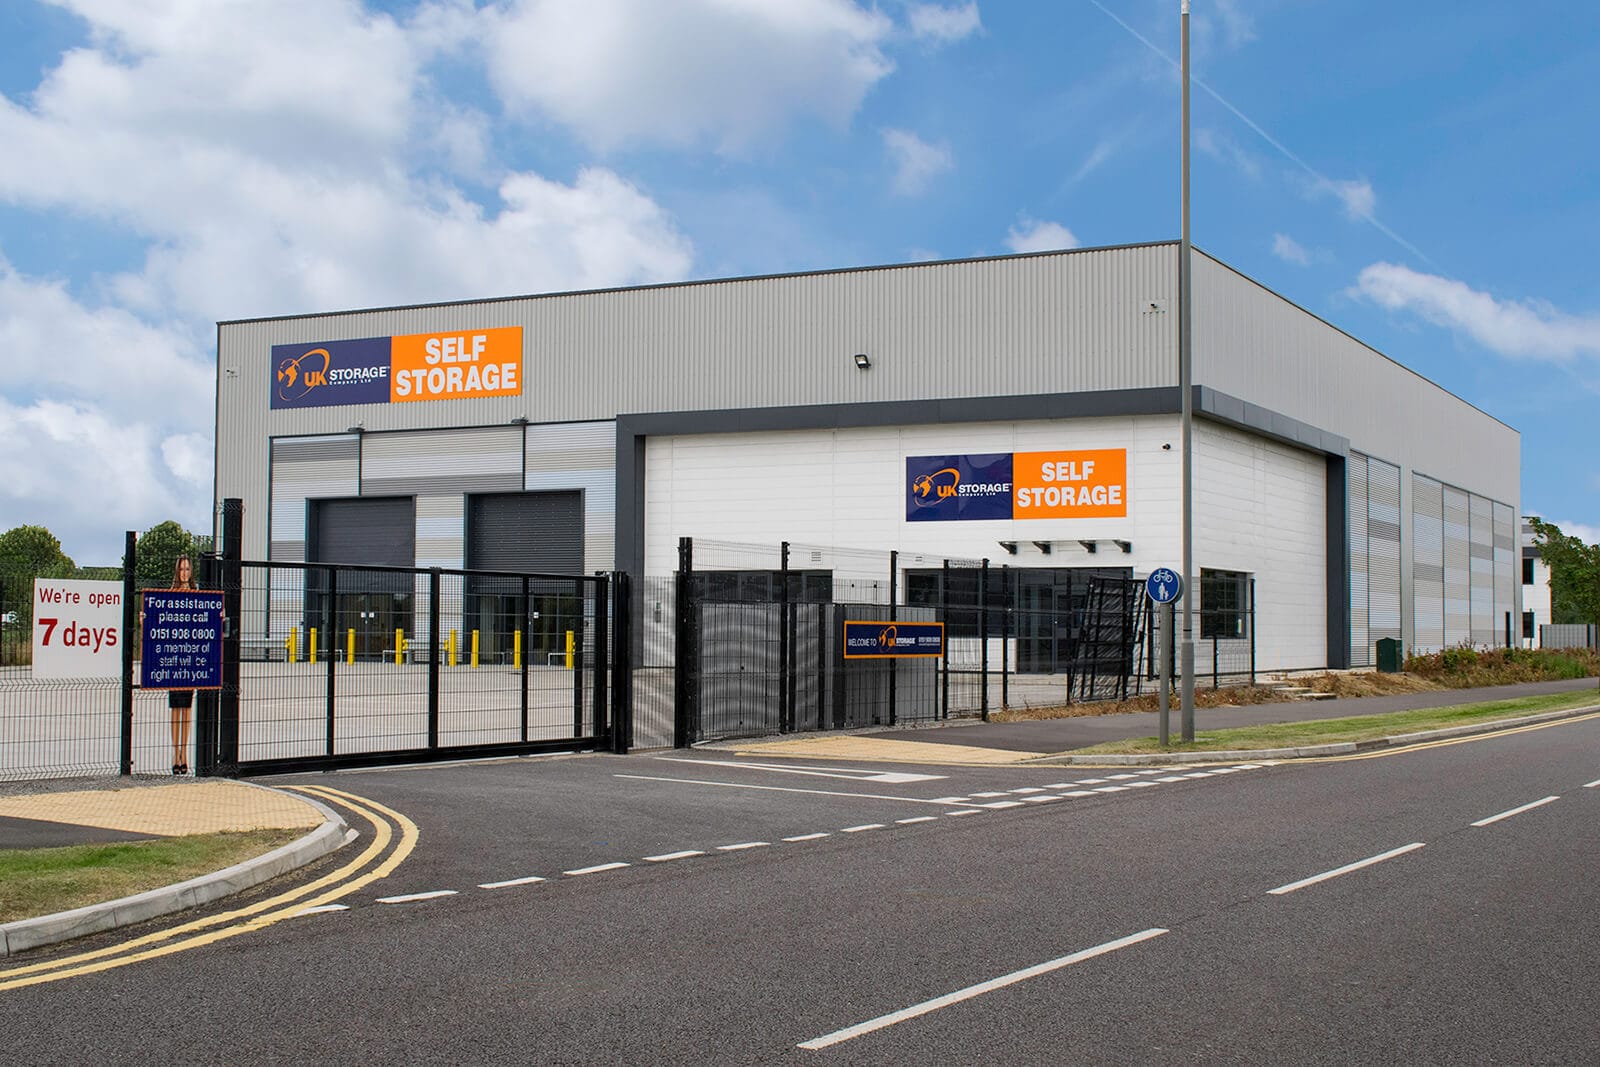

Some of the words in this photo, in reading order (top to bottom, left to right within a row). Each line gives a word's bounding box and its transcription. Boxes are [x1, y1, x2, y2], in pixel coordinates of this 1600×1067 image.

[425, 335, 487, 365] SELF
[304, 371, 328, 387] UK
[329, 366, 388, 381] STORAGE
[395, 362, 517, 396] STORAGE
[1041, 461, 1095, 482] SELF
[937, 485, 958, 497] UK
[958, 483, 1010, 494] STORAGE
[1017, 485, 1122, 508] STORAGE
[39, 587, 80, 604] We're
[88, 592, 120, 608] open
[167, 597, 222, 609] assistance
[158, 611, 191, 624] please
[192, 611, 209, 622] call
[38, 618, 58, 647] 7
[62, 620, 118, 653] days
[150, 628, 170, 639] 0151
[171, 628, 190, 639] 908
[192, 628, 215, 639] 0800
[155, 644, 162, 653] a
[164, 642, 200, 653] member
[201, 642, 210, 653] of
[847, 638, 870, 647] WELCOME
[159, 655, 178, 666] staff
[150, 668, 170, 682] right
[172, 668, 190, 679] with
